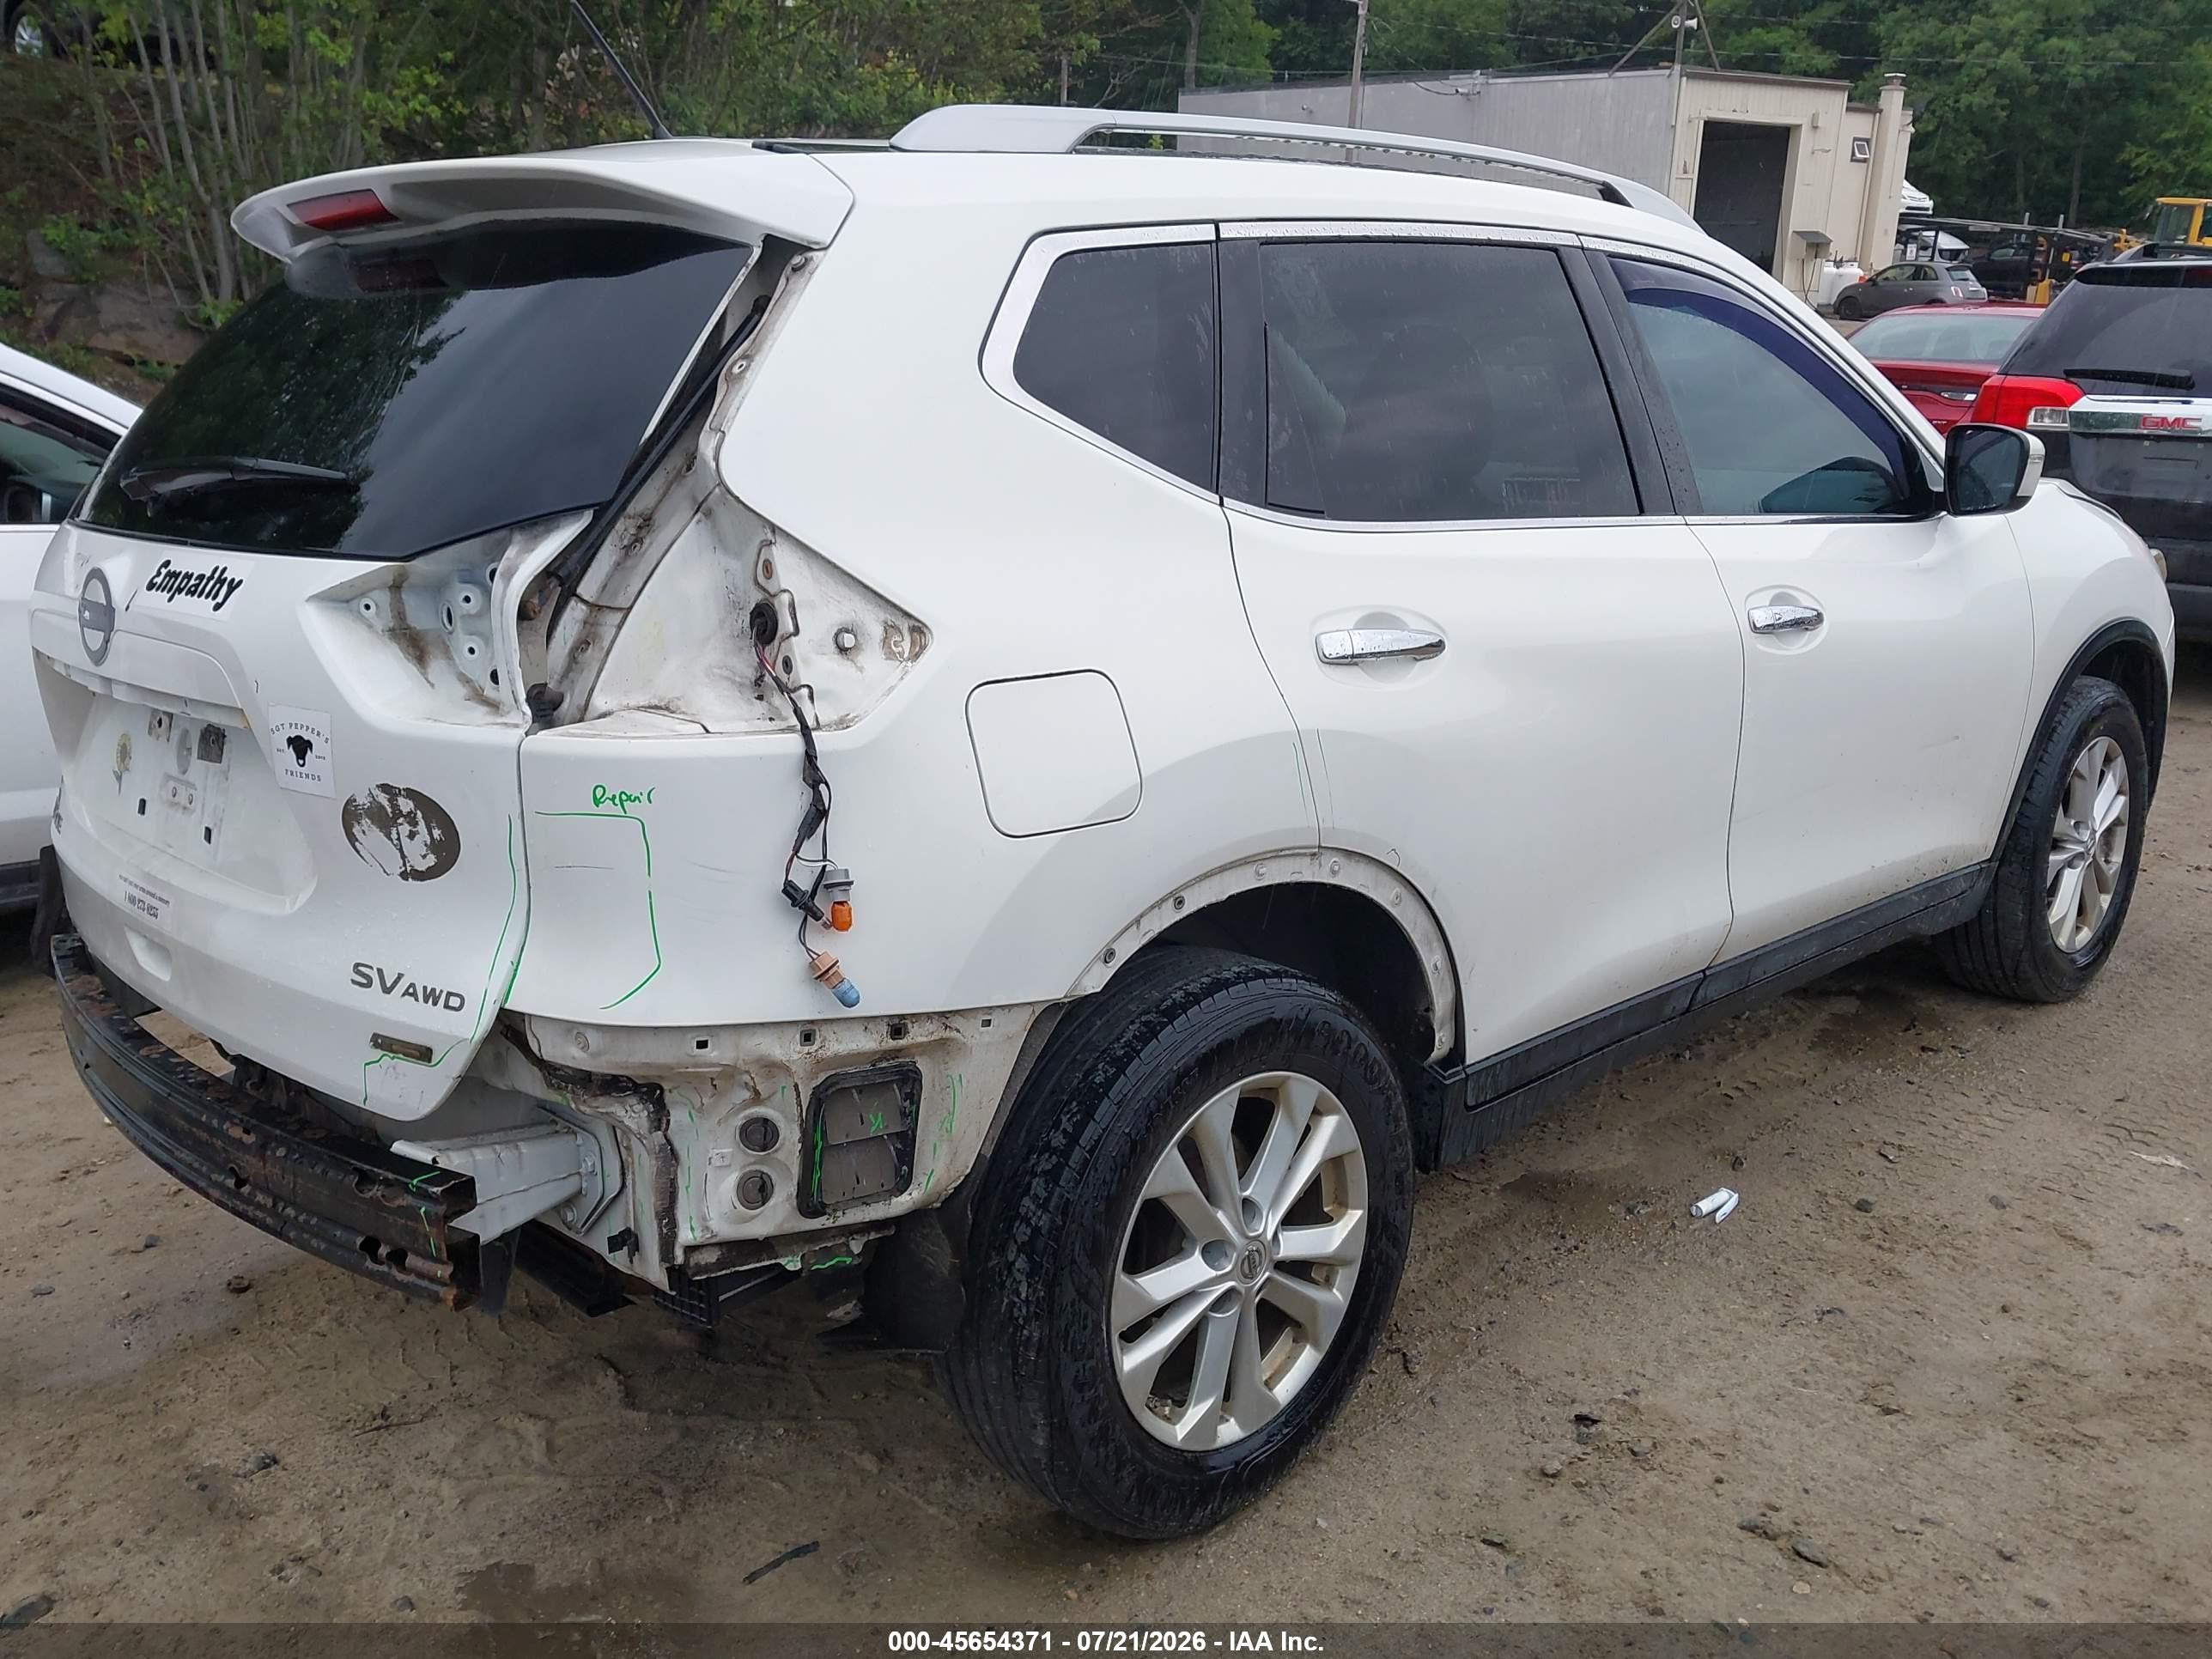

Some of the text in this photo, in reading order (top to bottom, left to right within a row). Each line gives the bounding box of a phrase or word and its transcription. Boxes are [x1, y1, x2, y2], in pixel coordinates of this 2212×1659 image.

[2141, 416, 2203, 429] GMC
[145, 559, 245, 612] Empathy
[284, 769, 322, 782] FRIENDS
[592, 784, 656, 815] Repair
[401, 982, 465, 1012] AWD
